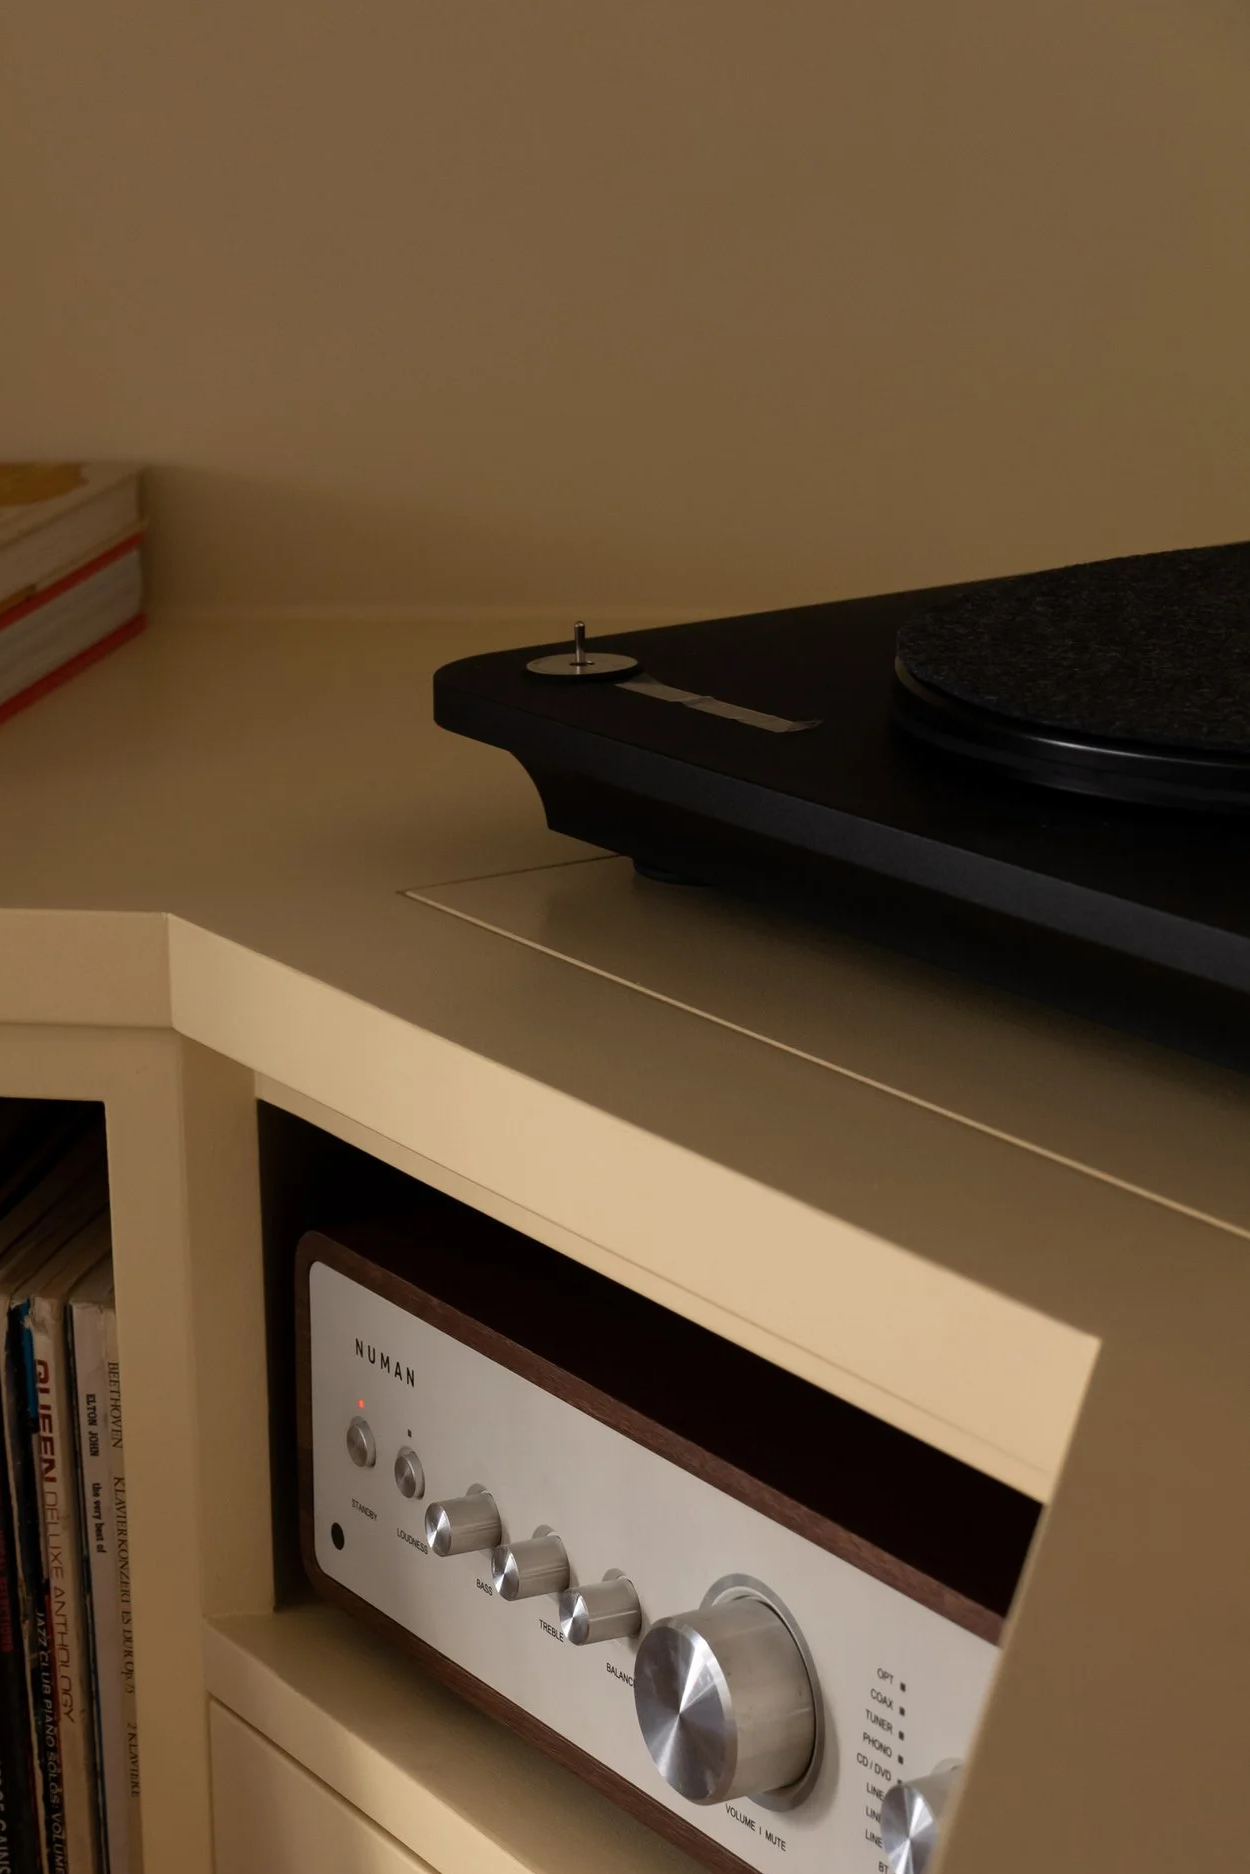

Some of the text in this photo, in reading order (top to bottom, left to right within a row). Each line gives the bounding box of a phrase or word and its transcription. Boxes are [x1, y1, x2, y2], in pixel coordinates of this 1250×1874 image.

[355, 1337, 415, 1388] NUMAN
[107, 1361, 124, 1449] BEETHOVEN
[86, 1393, 106, 1553] ELTON JOHN the very best of
[351, 1499, 378, 1520] STANDBY
[34, 1359, 76, 1723] QUEEN DELUXE ANTHOLOGY
[397, 1528, 429, 1555] LOUDNESS
[476, 1578, 493, 1596] BASS
[35, 1611, 49, 1648] JAZZ
[539, 1619, 564, 1643] TREBLE
[38, 1650, 52, 1693] CLUB
[606, 1662, 634, 1687] BALANC
[877, 1667, 894, 1685] OPT
[870, 1688, 894, 1711] COAX
[42, 1697, 56, 1748] PIANO
[865, 1708, 893, 1735] TUNER
[863, 1731, 893, 1758] PHONO
[725, 1803, 756, 1832] VOLUME
[765, 1829, 787, 1852] MUTE
[865, 1829, 883, 1848] LINE
[878, 1861, 889, 1874] BT
